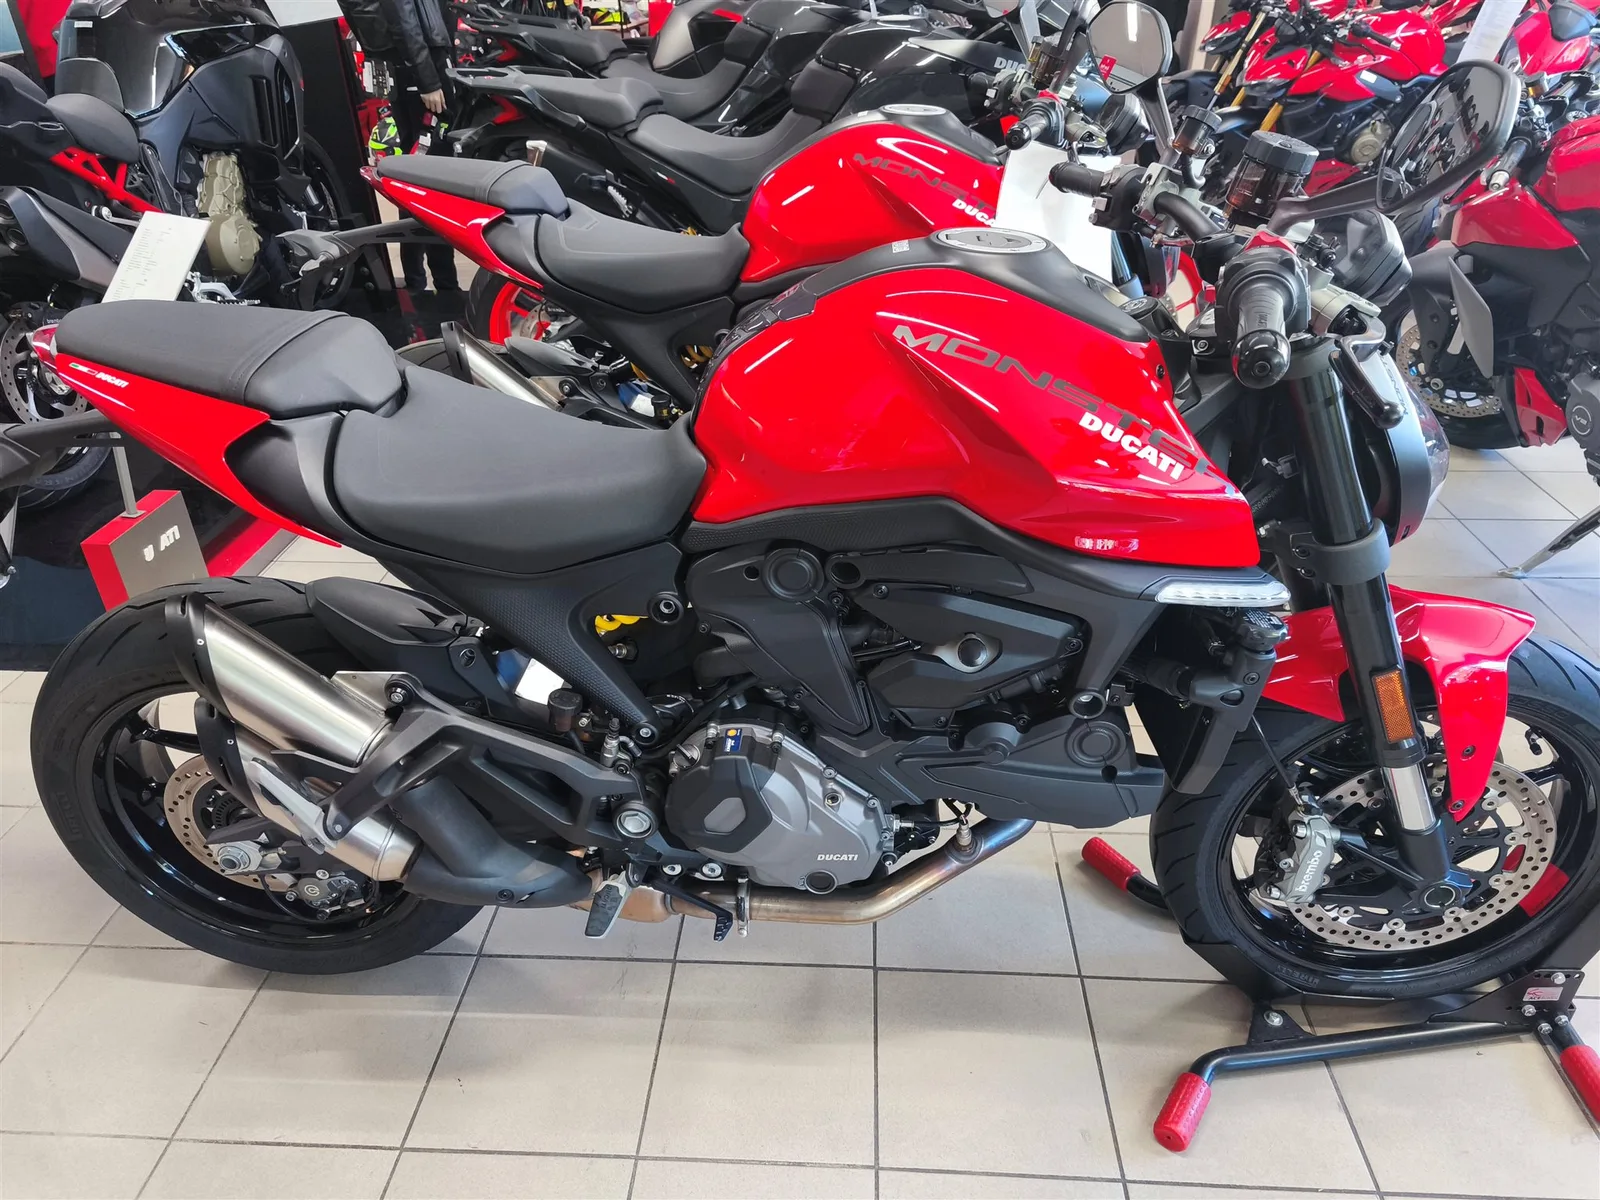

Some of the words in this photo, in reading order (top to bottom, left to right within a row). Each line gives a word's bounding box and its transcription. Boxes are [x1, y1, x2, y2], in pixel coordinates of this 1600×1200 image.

[853, 153, 997, 213] MONST
[1079, 411, 1186, 480] DUCATI
[816, 853, 859, 861] DUCATI
[1295, 850, 1323, 892] brembo
